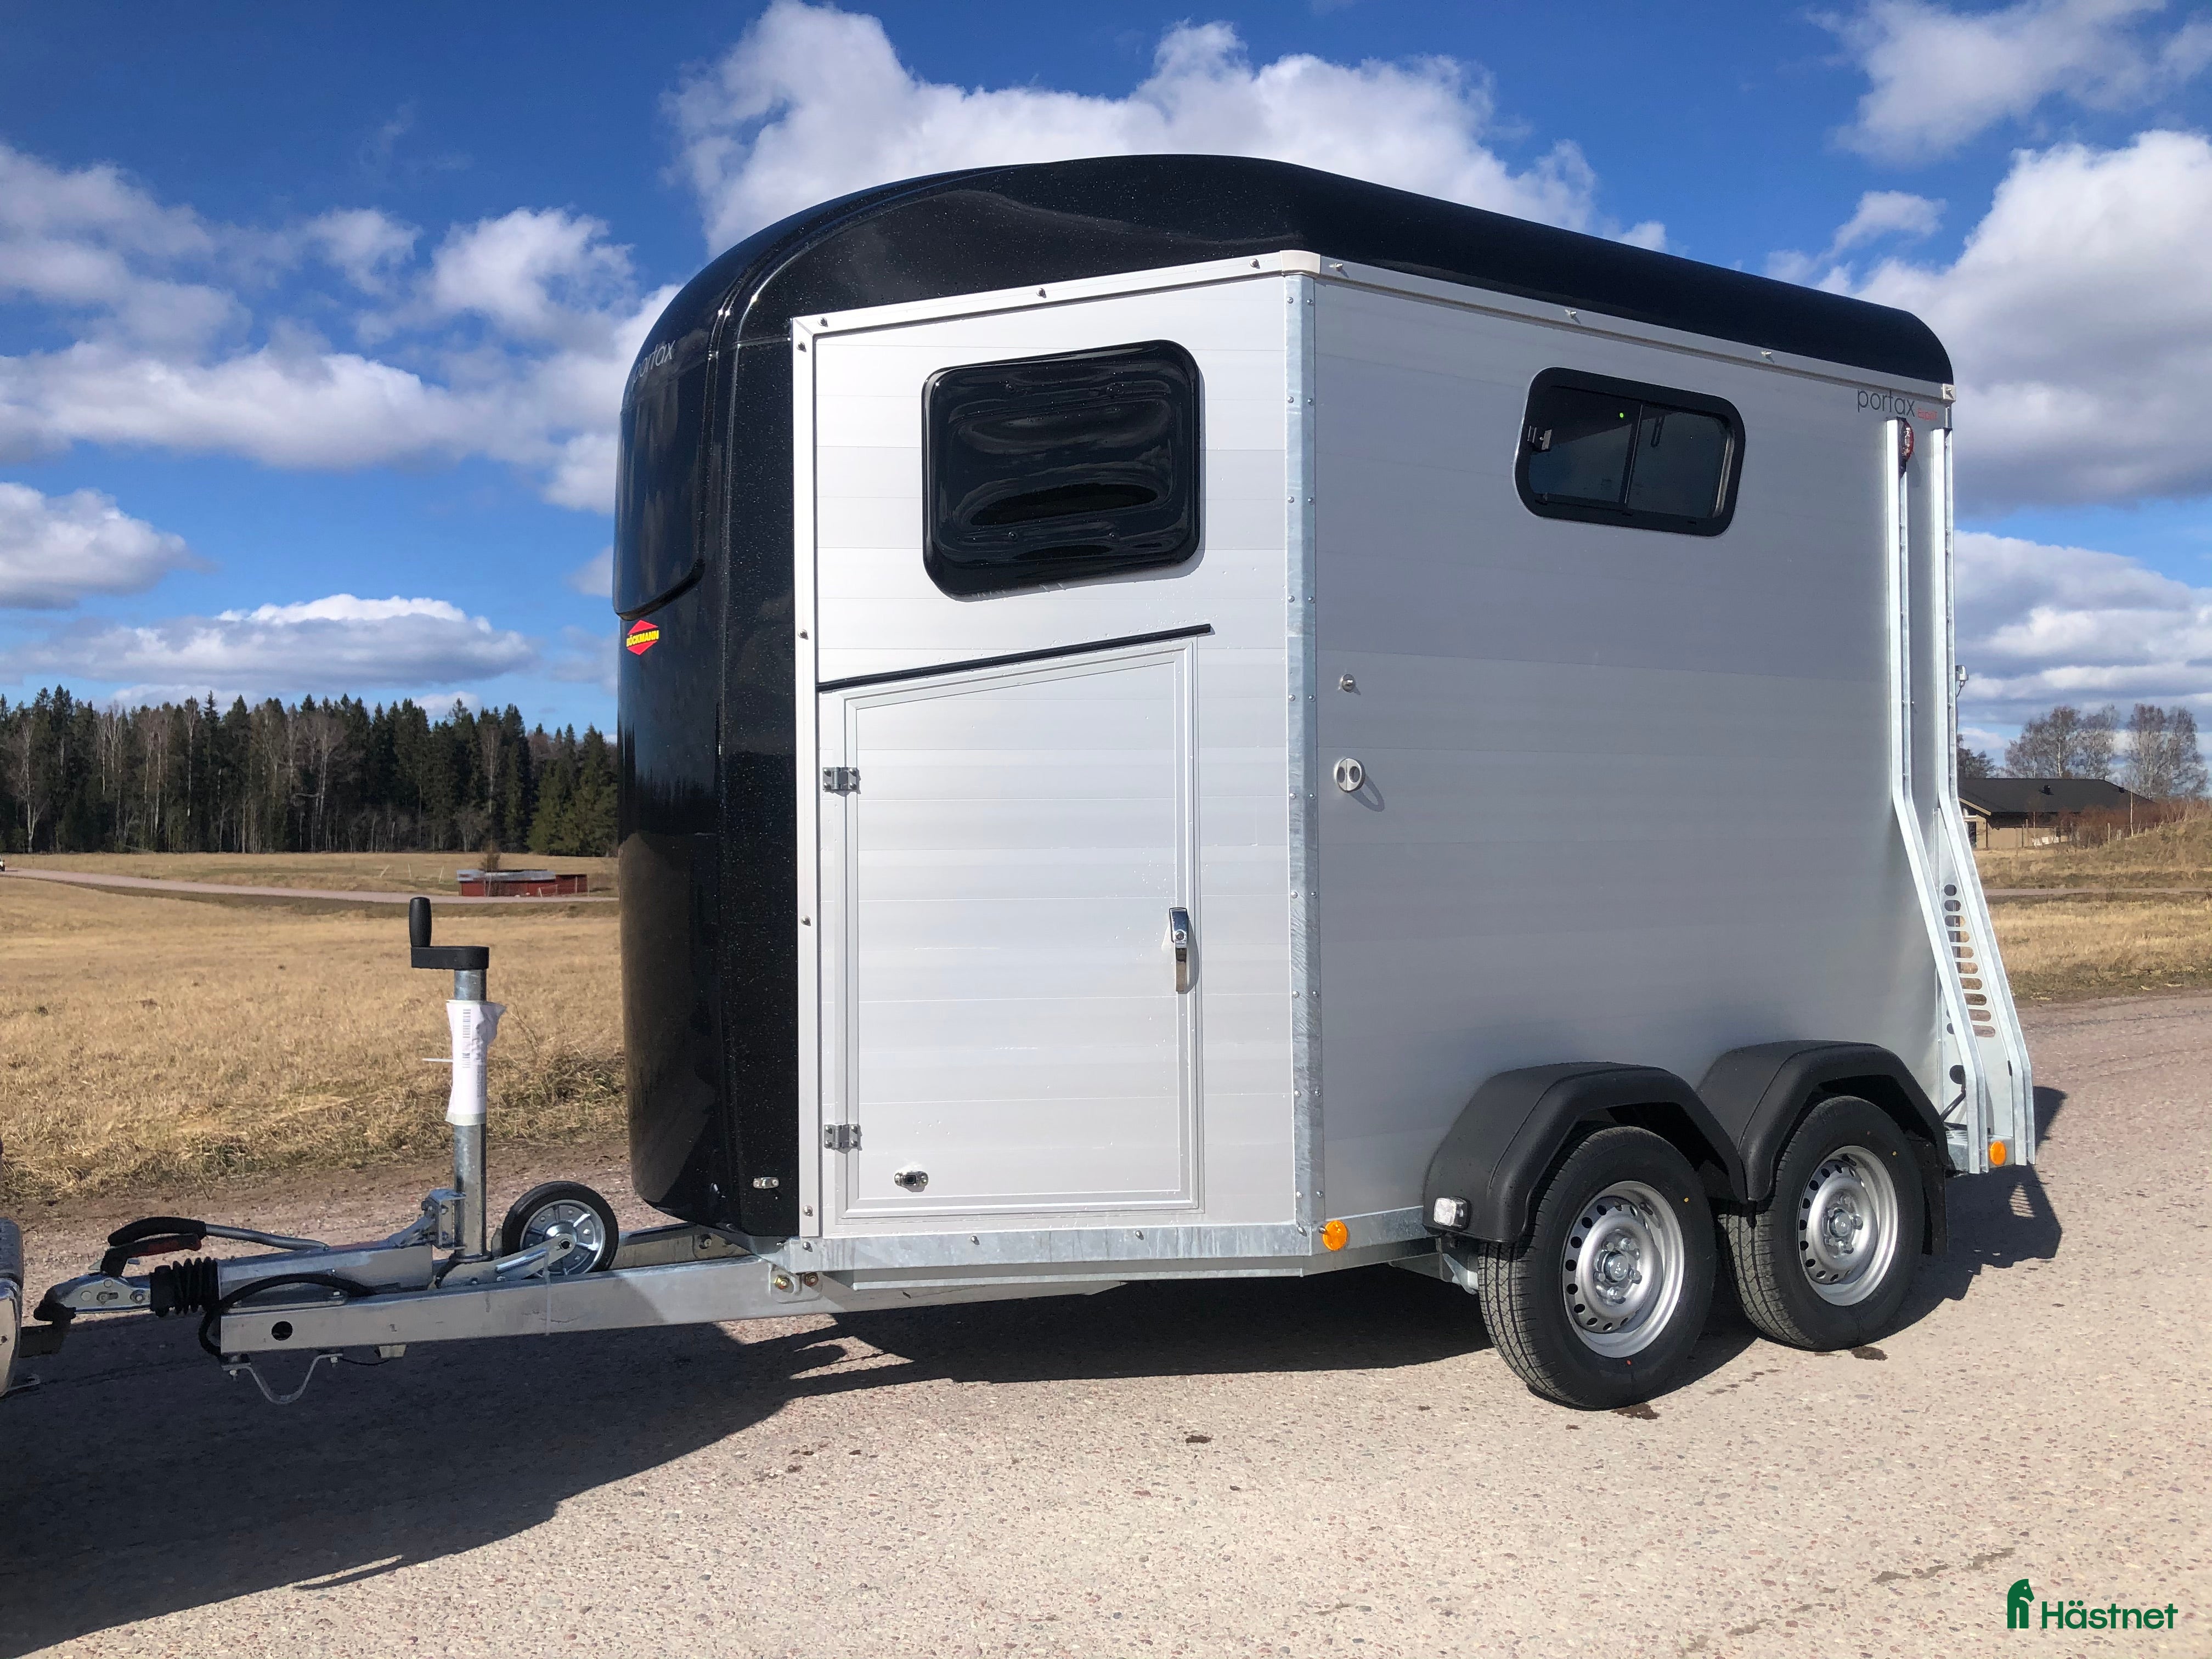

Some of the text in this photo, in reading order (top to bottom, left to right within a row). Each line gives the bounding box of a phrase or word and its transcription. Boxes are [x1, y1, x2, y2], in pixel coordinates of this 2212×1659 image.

[631, 340, 676, 391] portax
[1857, 390, 1915, 417] portax
[626, 629, 659, 647] BÖCKMANN
